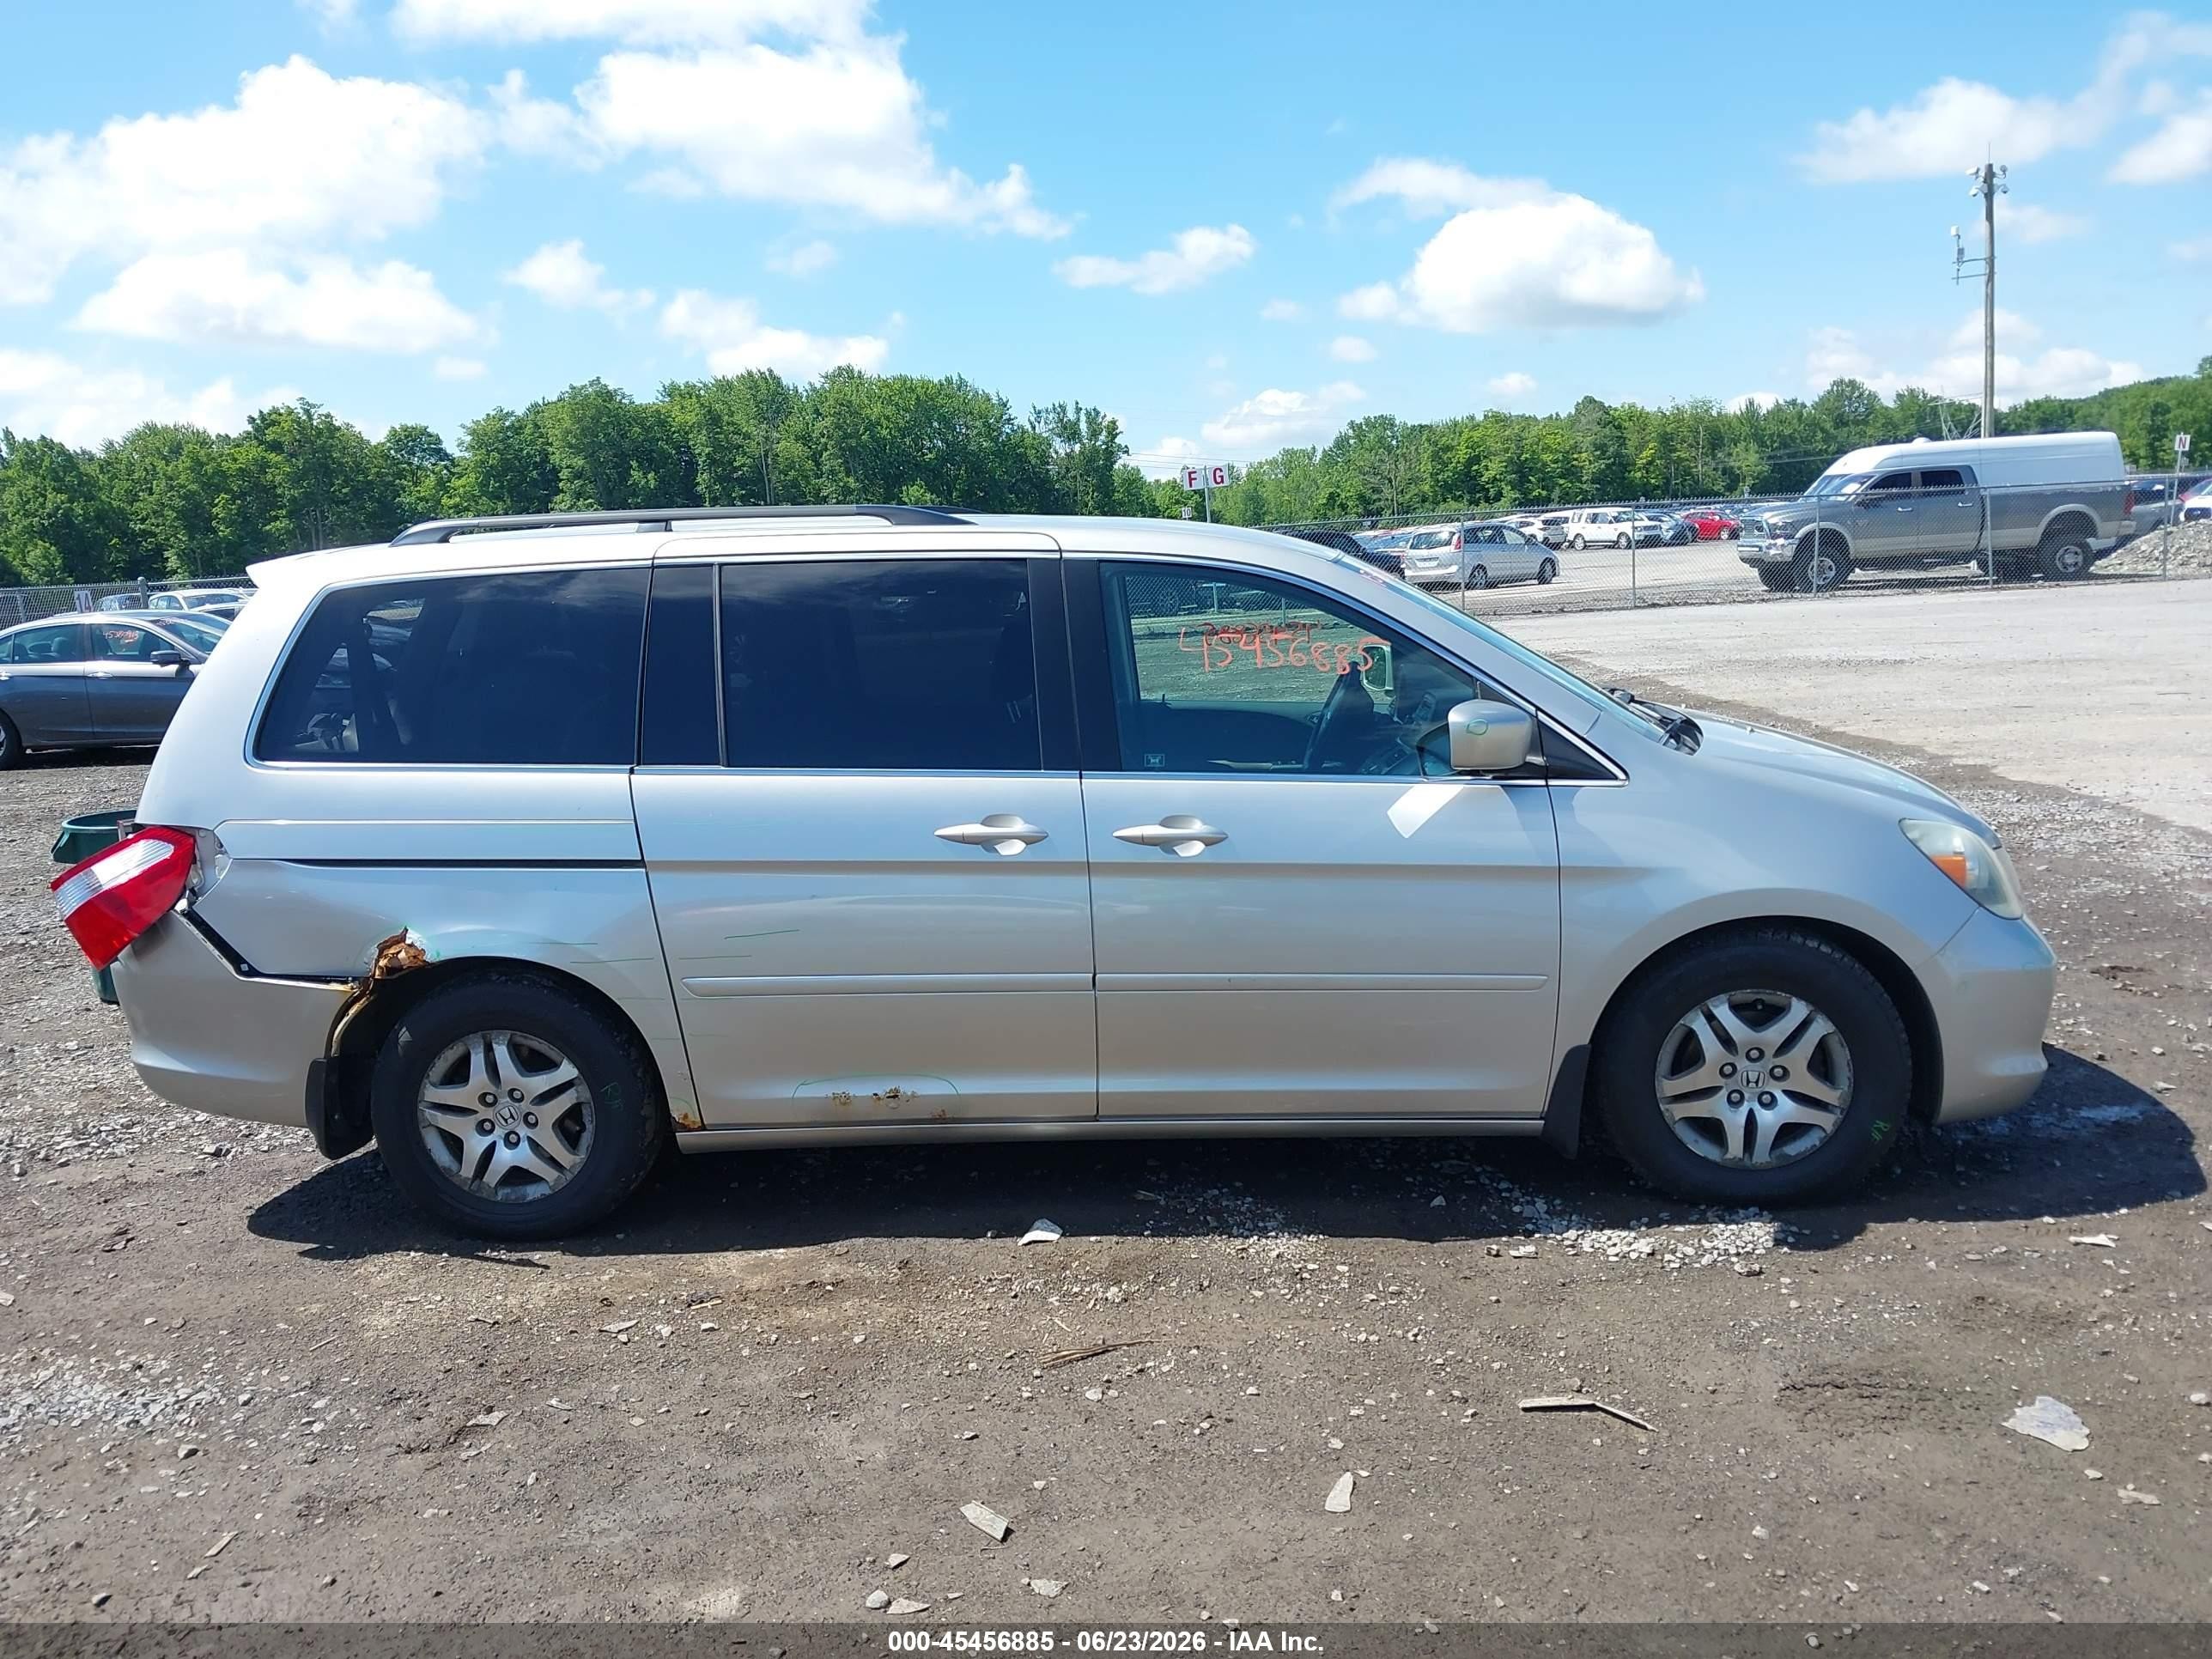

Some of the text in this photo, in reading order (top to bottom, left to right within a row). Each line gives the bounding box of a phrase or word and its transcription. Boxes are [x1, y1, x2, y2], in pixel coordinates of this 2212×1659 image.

[2178, 436, 2187, 449] N
[1188, 471, 1198, 489] F
[1212, 467, 1224, 485] G
[1182, 508, 1192, 517] 10
[1179, 627, 1392, 675] 45456885
